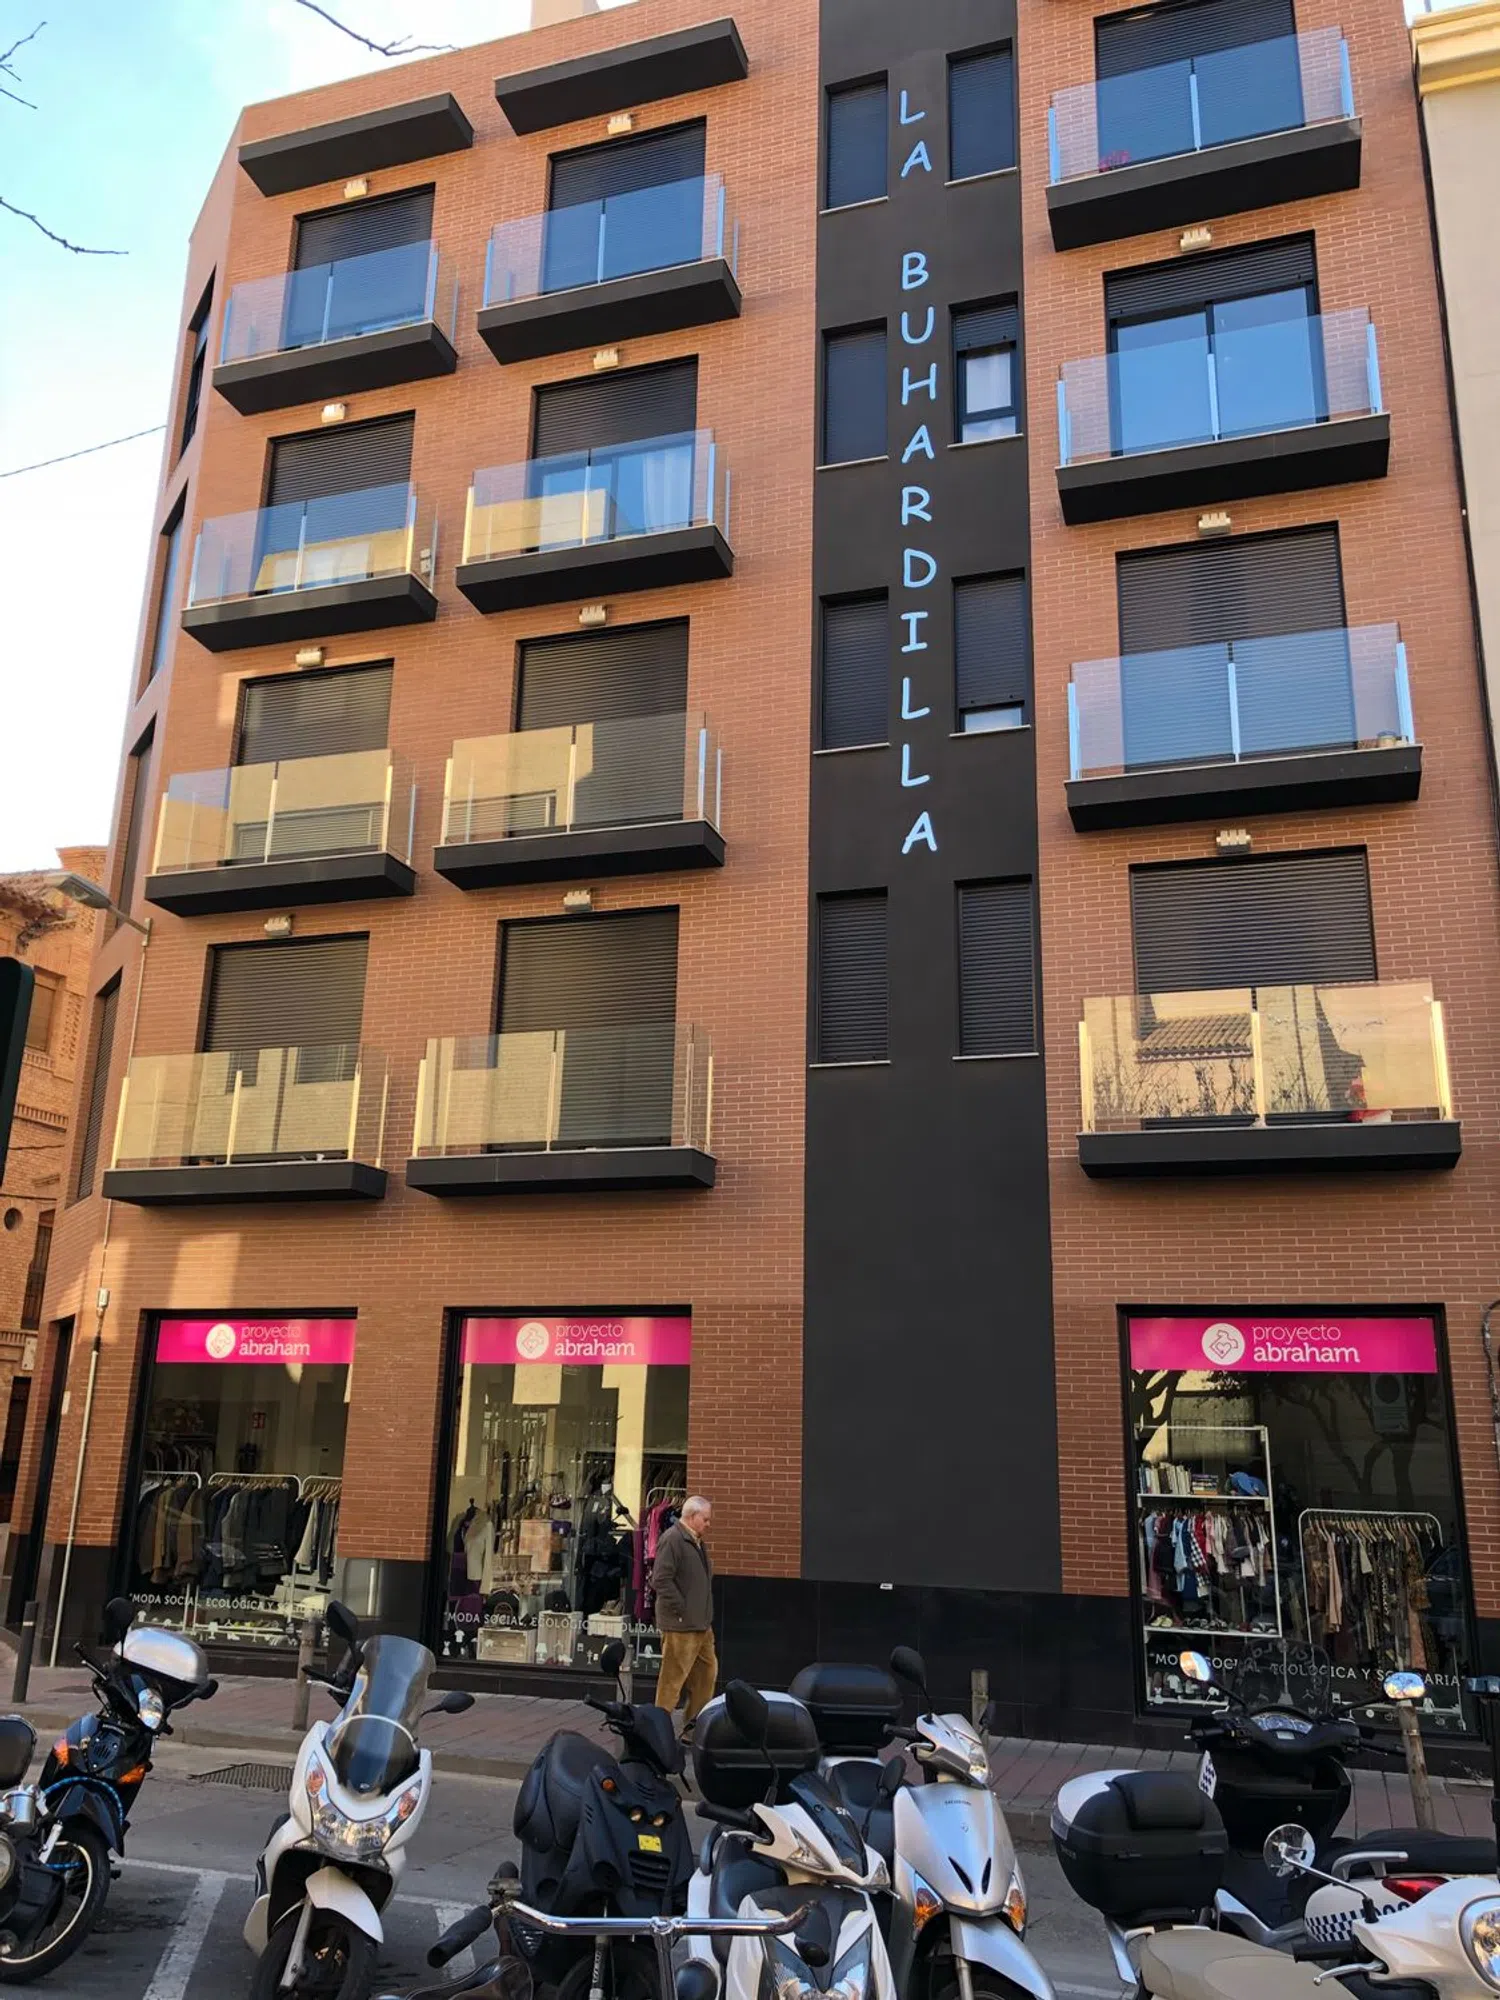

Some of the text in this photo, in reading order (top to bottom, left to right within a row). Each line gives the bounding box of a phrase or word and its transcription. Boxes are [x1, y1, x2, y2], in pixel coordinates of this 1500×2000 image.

[900, 90, 938, 855] LA BUHARDILLA
[241, 1325, 301, 1342] proyecto
[555, 1323, 624, 1341] proyecto
[1252, 1325, 1341, 1345] proyecto
[239, 1339, 311, 1356] abraham
[554, 1339, 636, 1356] abraham
[1253, 1342, 1360, 1363] abraham
[1361, 1667, 1371, 1680] Y
